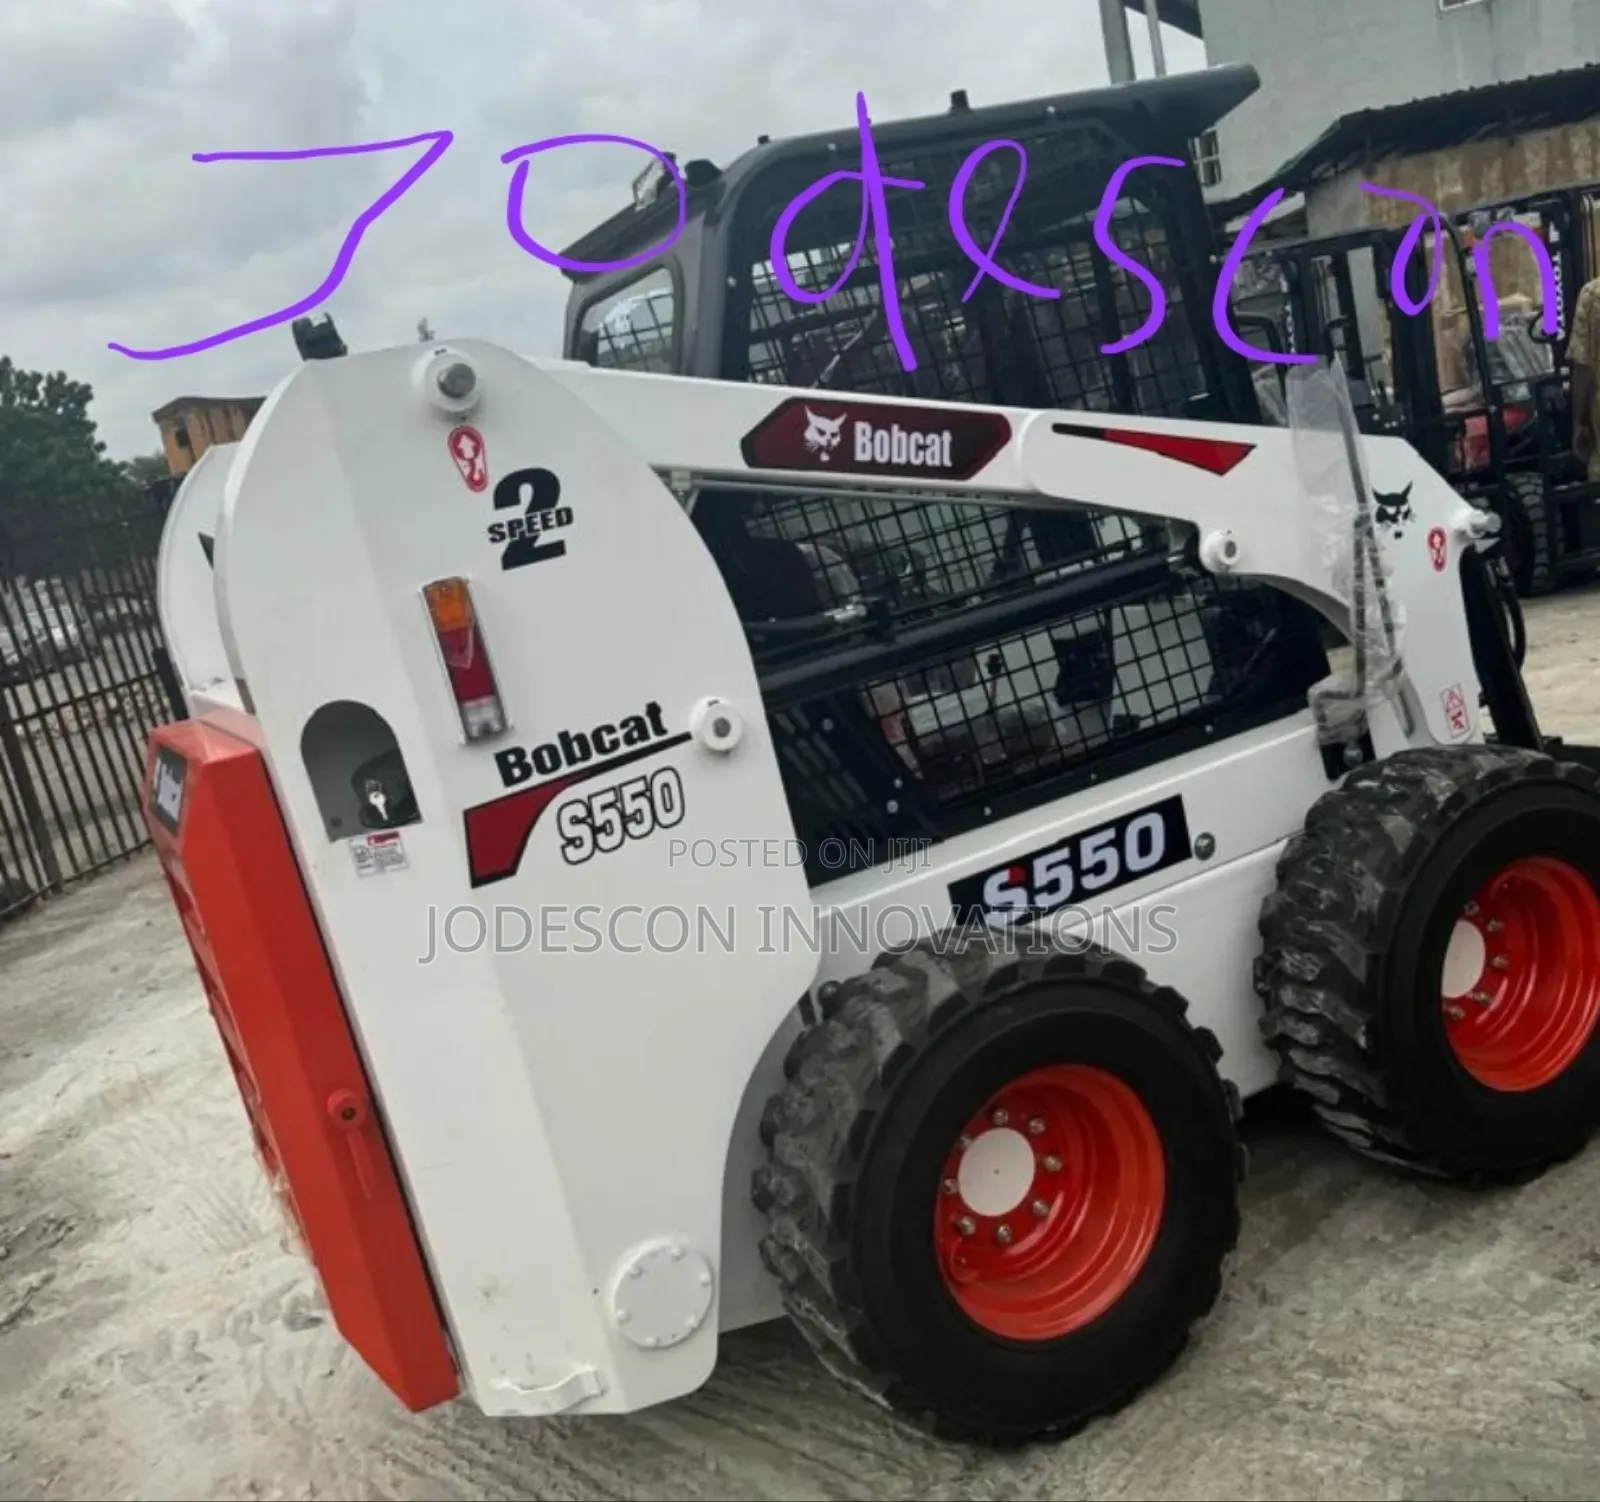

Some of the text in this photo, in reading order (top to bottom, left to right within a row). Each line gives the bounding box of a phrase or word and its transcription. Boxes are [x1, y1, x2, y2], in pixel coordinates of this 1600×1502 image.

[854, 420, 953, 468] Bobcat
[487, 506, 574, 544] SPEED
[493, 467, 567, 571] 2
[493, 700, 669, 788] Bobcat
[556, 765, 686, 866] S550
[982, 811, 1166, 928] S550
